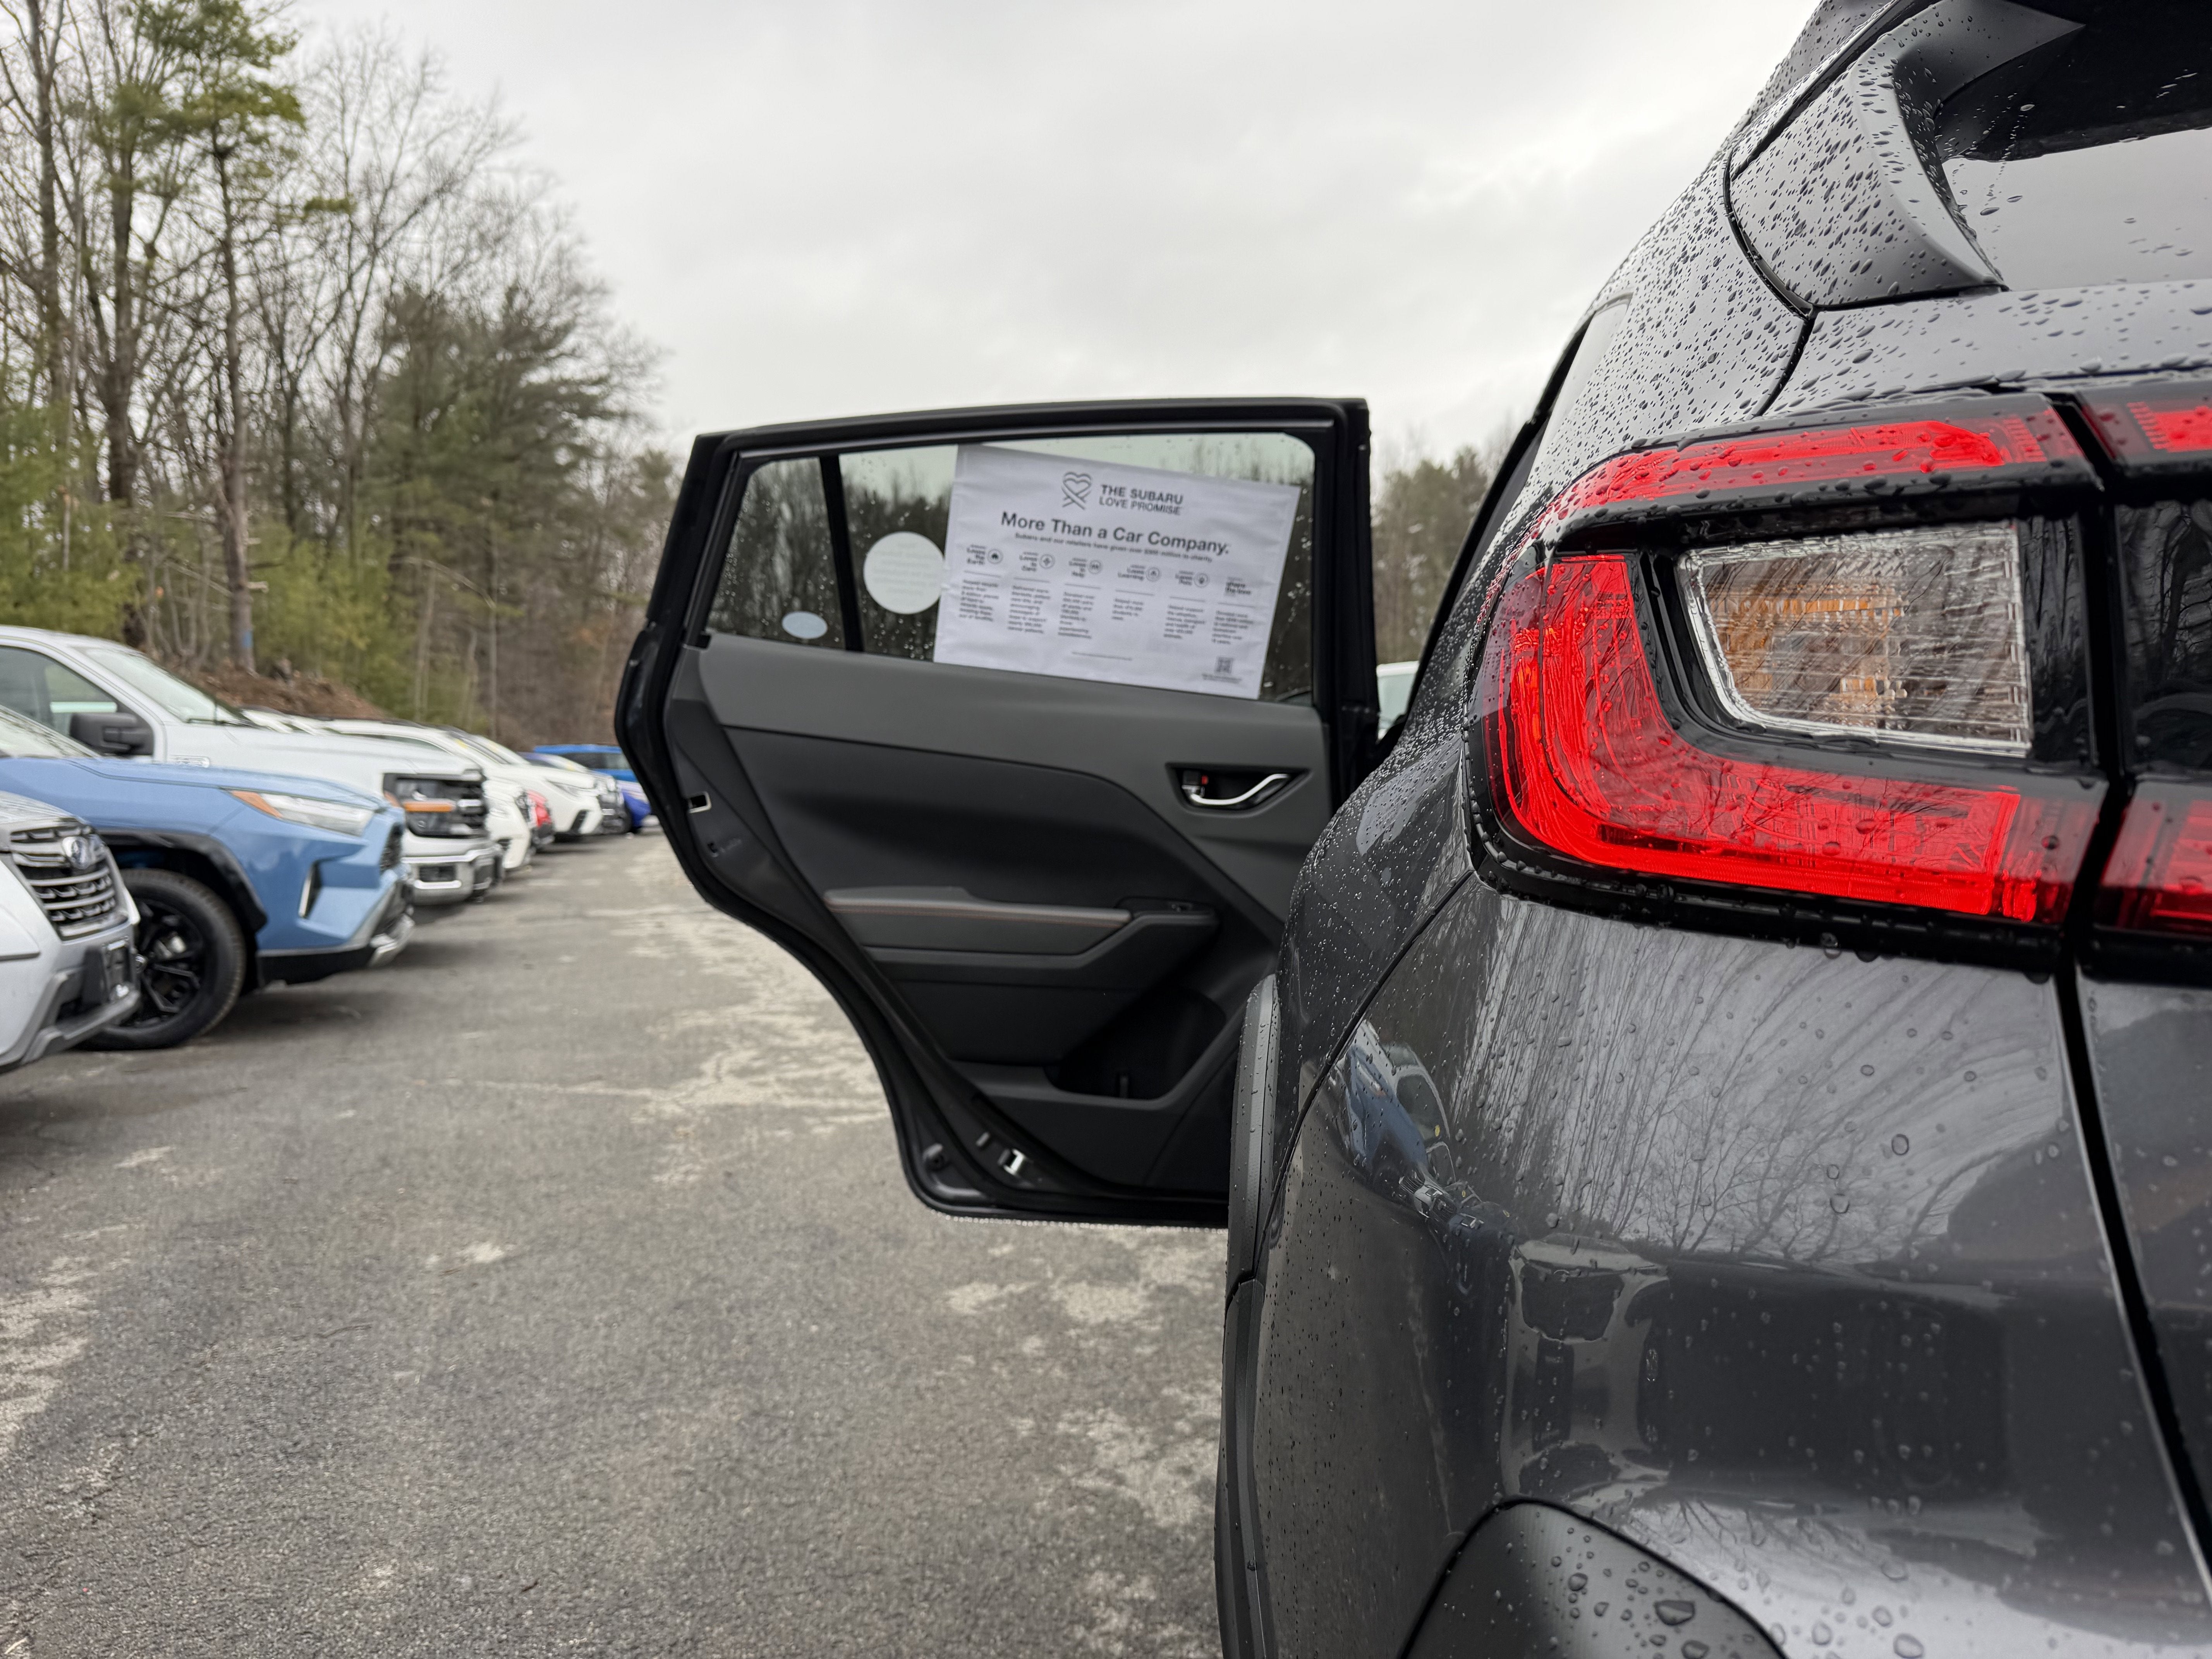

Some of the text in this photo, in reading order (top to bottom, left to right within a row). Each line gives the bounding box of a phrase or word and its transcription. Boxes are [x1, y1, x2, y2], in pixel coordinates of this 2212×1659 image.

[1101, 484, 1184, 505] THE SUBARU
[1099, 496, 1181, 515] LOVE PROMISE
[1001, 511, 1229, 556] More Than a Car Company.
